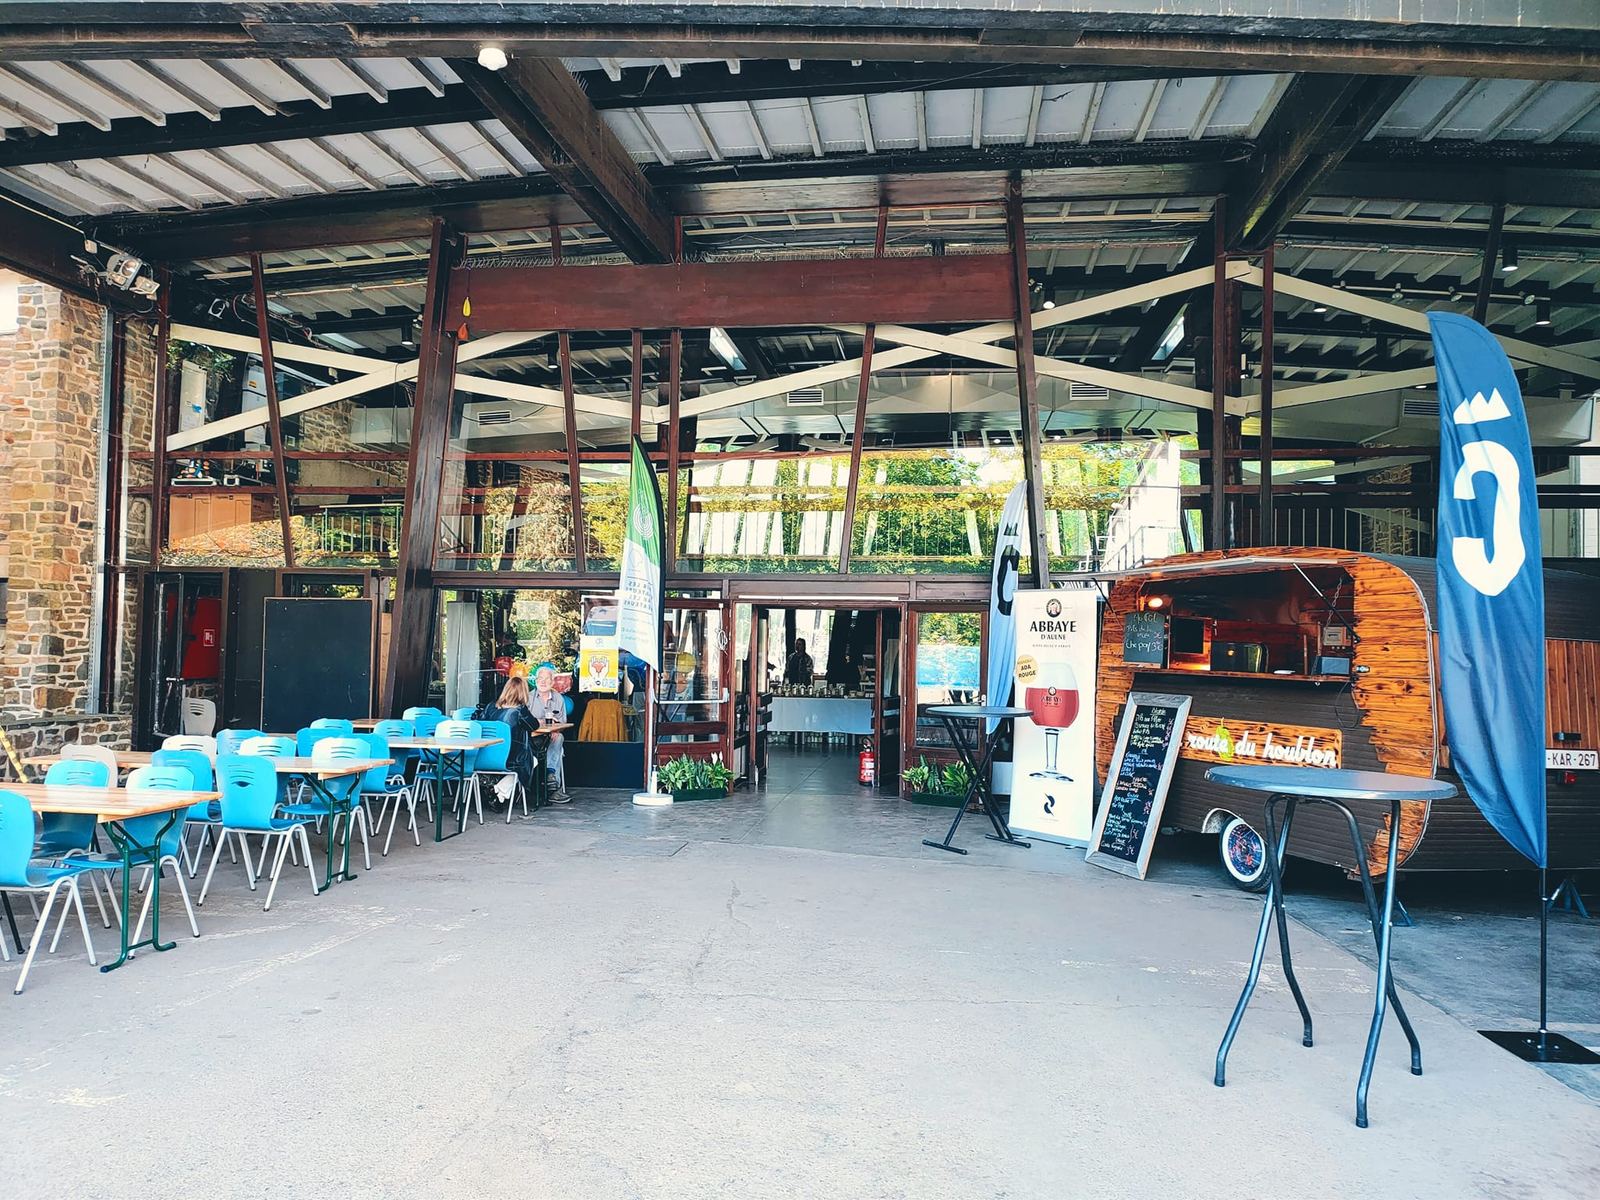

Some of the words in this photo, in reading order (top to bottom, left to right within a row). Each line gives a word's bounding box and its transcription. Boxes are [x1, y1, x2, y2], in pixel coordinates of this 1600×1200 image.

[1029, 620, 1077, 632] ABBAYE
[1235, 730, 1256, 756] du
[1262, 732, 1336, 768] houblon
